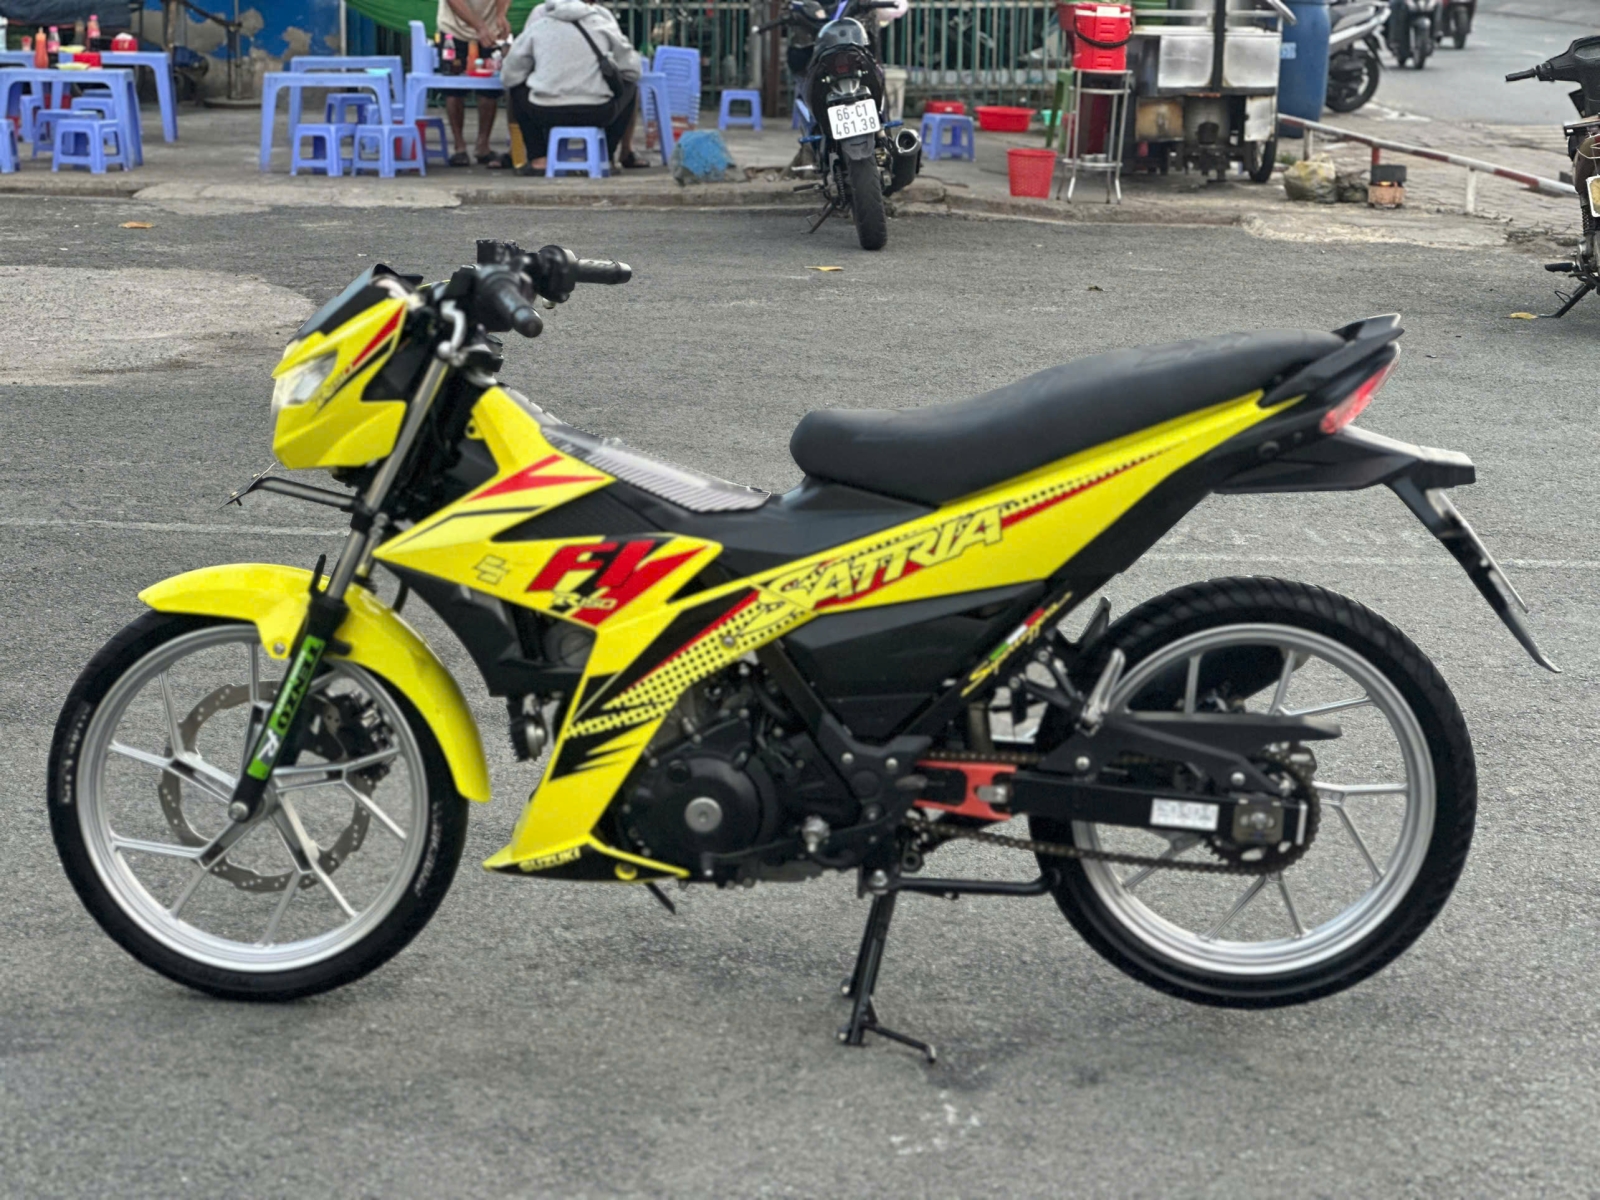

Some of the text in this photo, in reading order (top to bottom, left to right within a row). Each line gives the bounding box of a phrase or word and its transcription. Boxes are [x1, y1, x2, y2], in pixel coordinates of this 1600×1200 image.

[836, 103, 868, 121] 66-C1
[835, 117, 877, 137] 461.38
[740, 504, 1003, 635] SATRIA
[519, 847, 581, 872] SUZUKI
